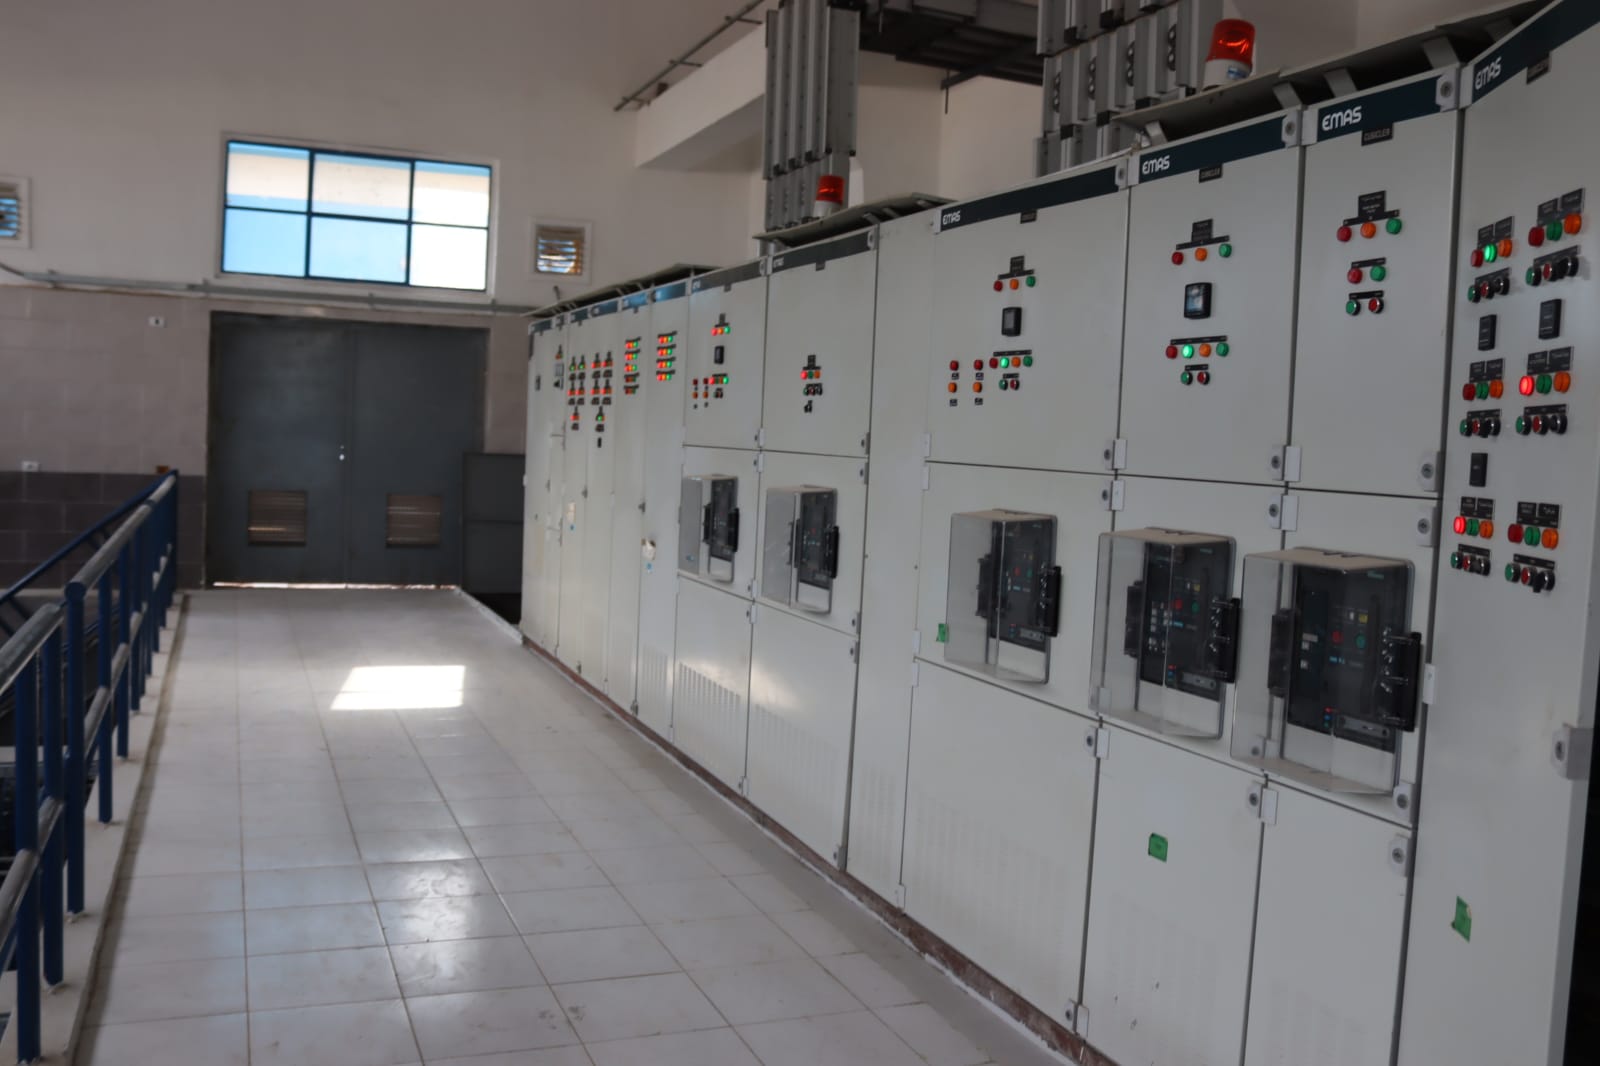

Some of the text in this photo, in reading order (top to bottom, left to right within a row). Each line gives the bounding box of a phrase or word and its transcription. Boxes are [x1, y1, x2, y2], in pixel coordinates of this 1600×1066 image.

[1475, 56, 1502, 90] EMAS
[1322, 106, 1362, 131] EMAS
[1142, 155, 1170, 175] EMAS
